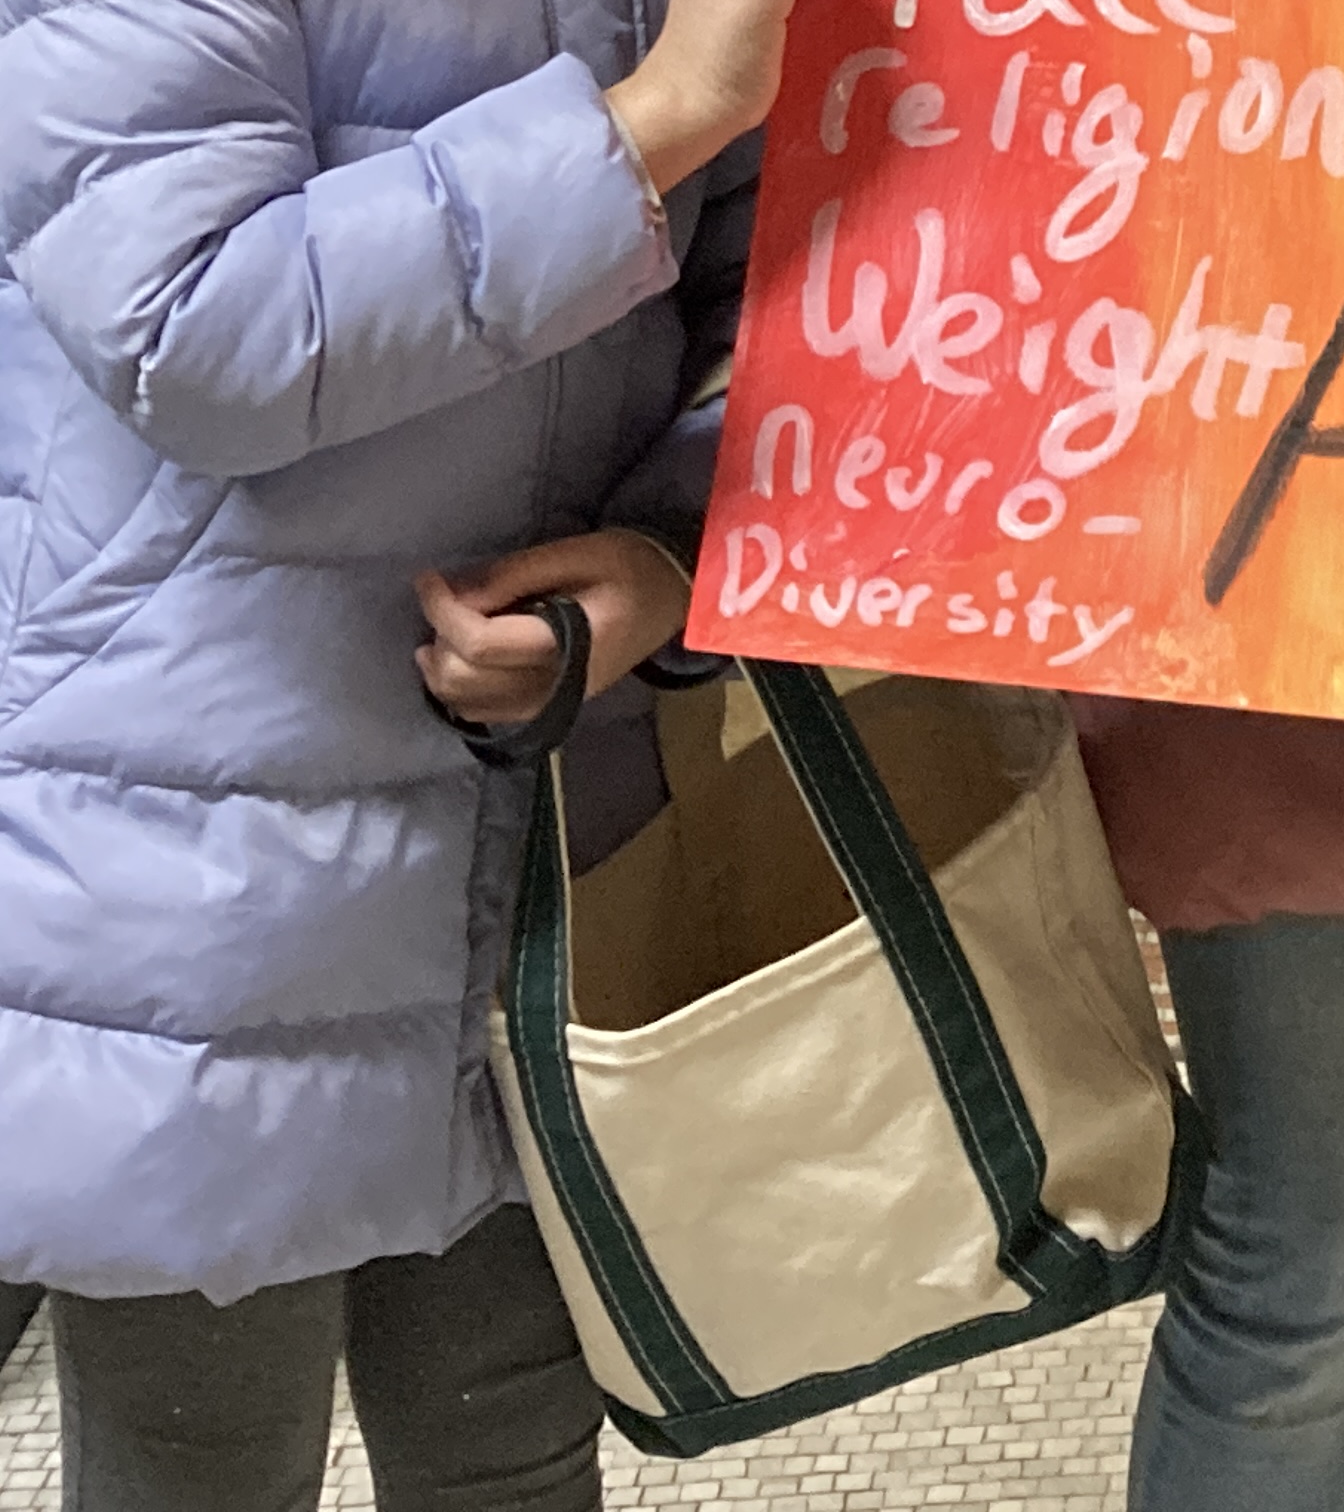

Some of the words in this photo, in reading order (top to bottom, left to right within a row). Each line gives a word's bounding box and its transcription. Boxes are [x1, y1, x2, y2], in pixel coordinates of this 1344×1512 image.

[800, 199, 1309, 480] Weight
[751, 404, 1142, 543] neuro-
[718, 523, 1138, 668] Diversity
